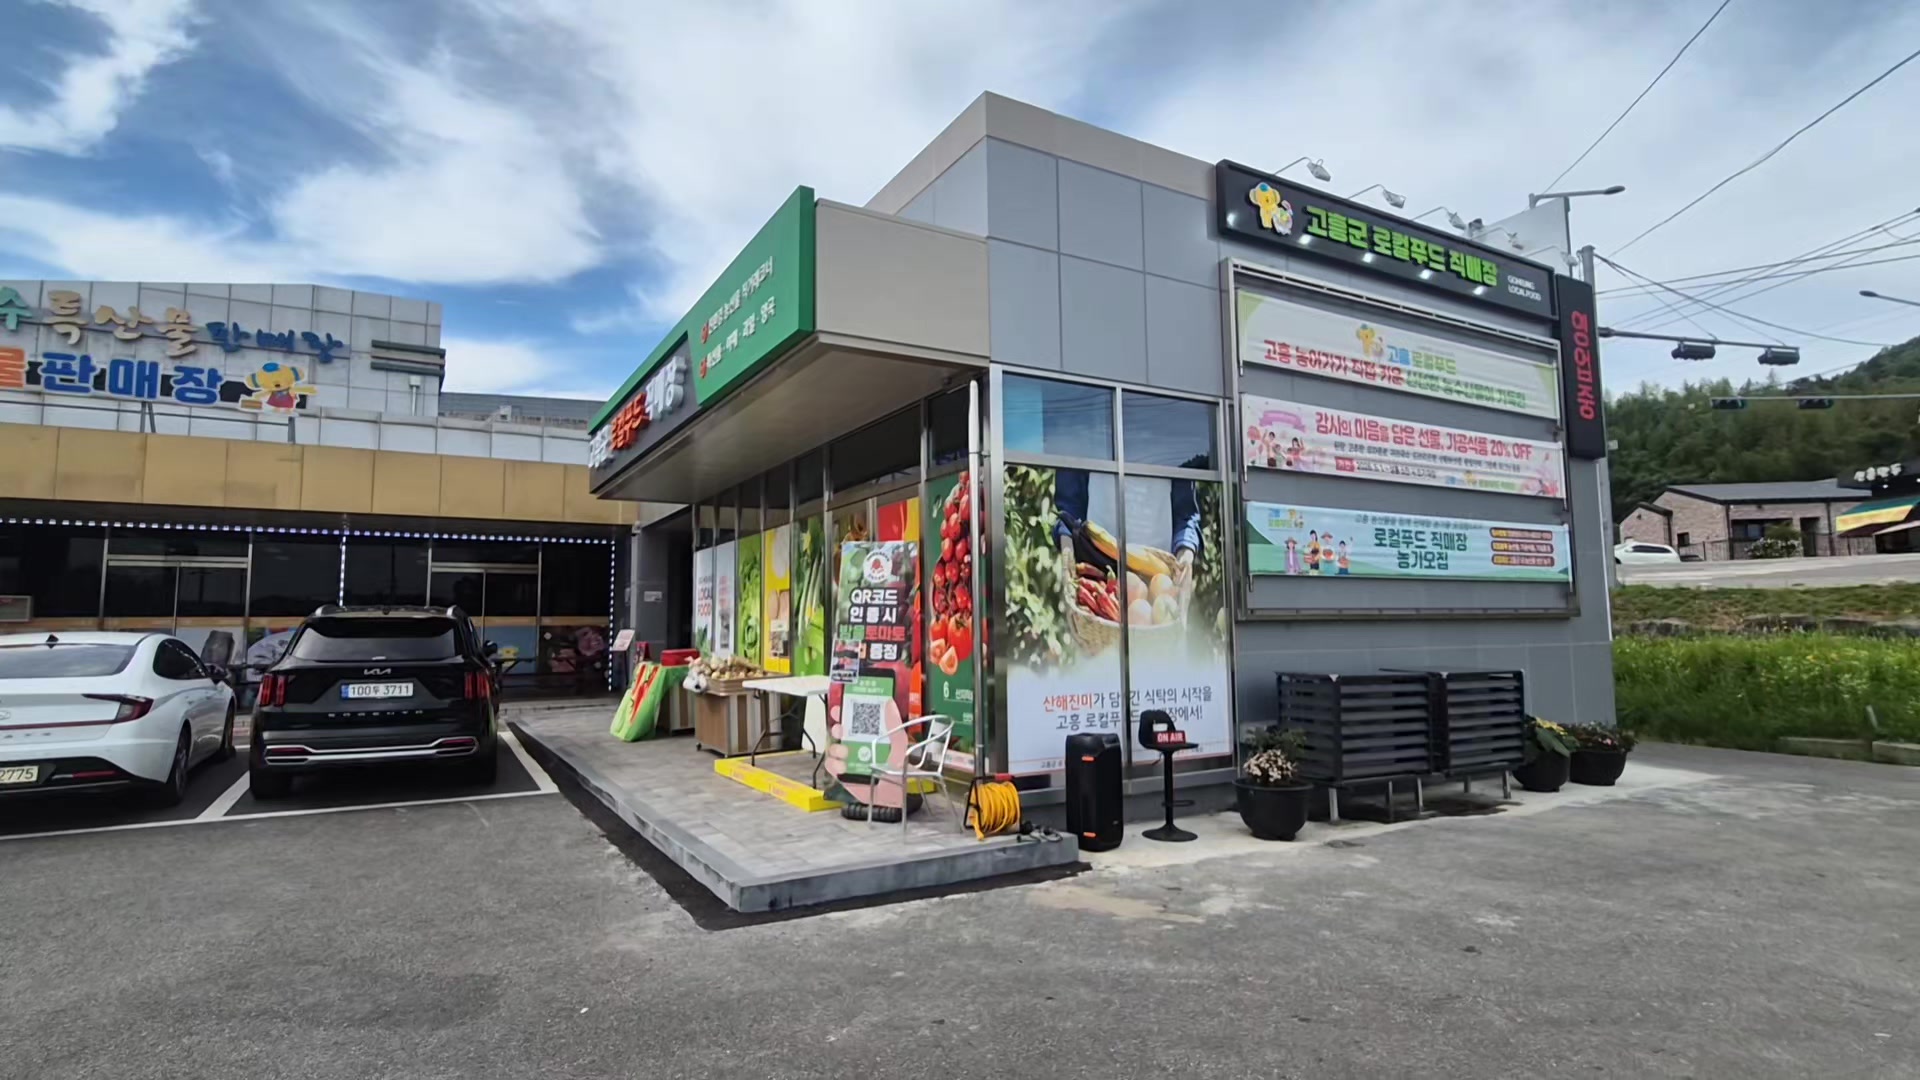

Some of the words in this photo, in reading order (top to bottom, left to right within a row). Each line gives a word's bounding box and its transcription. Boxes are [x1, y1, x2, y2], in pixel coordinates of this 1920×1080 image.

[1306, 205, 1369, 250] 고흥군
[1373, 225, 1446, 272] 로컬푸드
[1449, 249, 1498, 287] 직매장
[1263, 339, 1292, 364] 고흥
[1351, 358, 1376, 381] 직접
[41, 352, 223, 404] 판매장
[1315, 411, 1352, 437] 감사의
[1355, 418, 1390, 443] 마음을
[1391, 424, 1416, 447] 담은
[1446, 432, 1488, 456] 가공식품
[1490, 440, 1511, 457] 20%
[1512, 443, 1533, 460] OFF
[1374, 528, 1427, 549] 로컬푸드
[1430, 531, 1468, 551] 직매장
[1397, 550, 1449, 570] 농가모집
[850, 589, 898, 605] QR코드
[383, 685, 409, 695] 3711
[943, 681, 950, 698] 6
[1043, 692, 1105, 713] 산해진미가
[1144, 687, 1177, 704] 식탁의
[1181, 686, 1212, 703] 시작을
[1056, 713, 1081, 731] 고흥
[1157, 733, 1169, 743] ON
[1170, 732, 1184, 742] AIR
